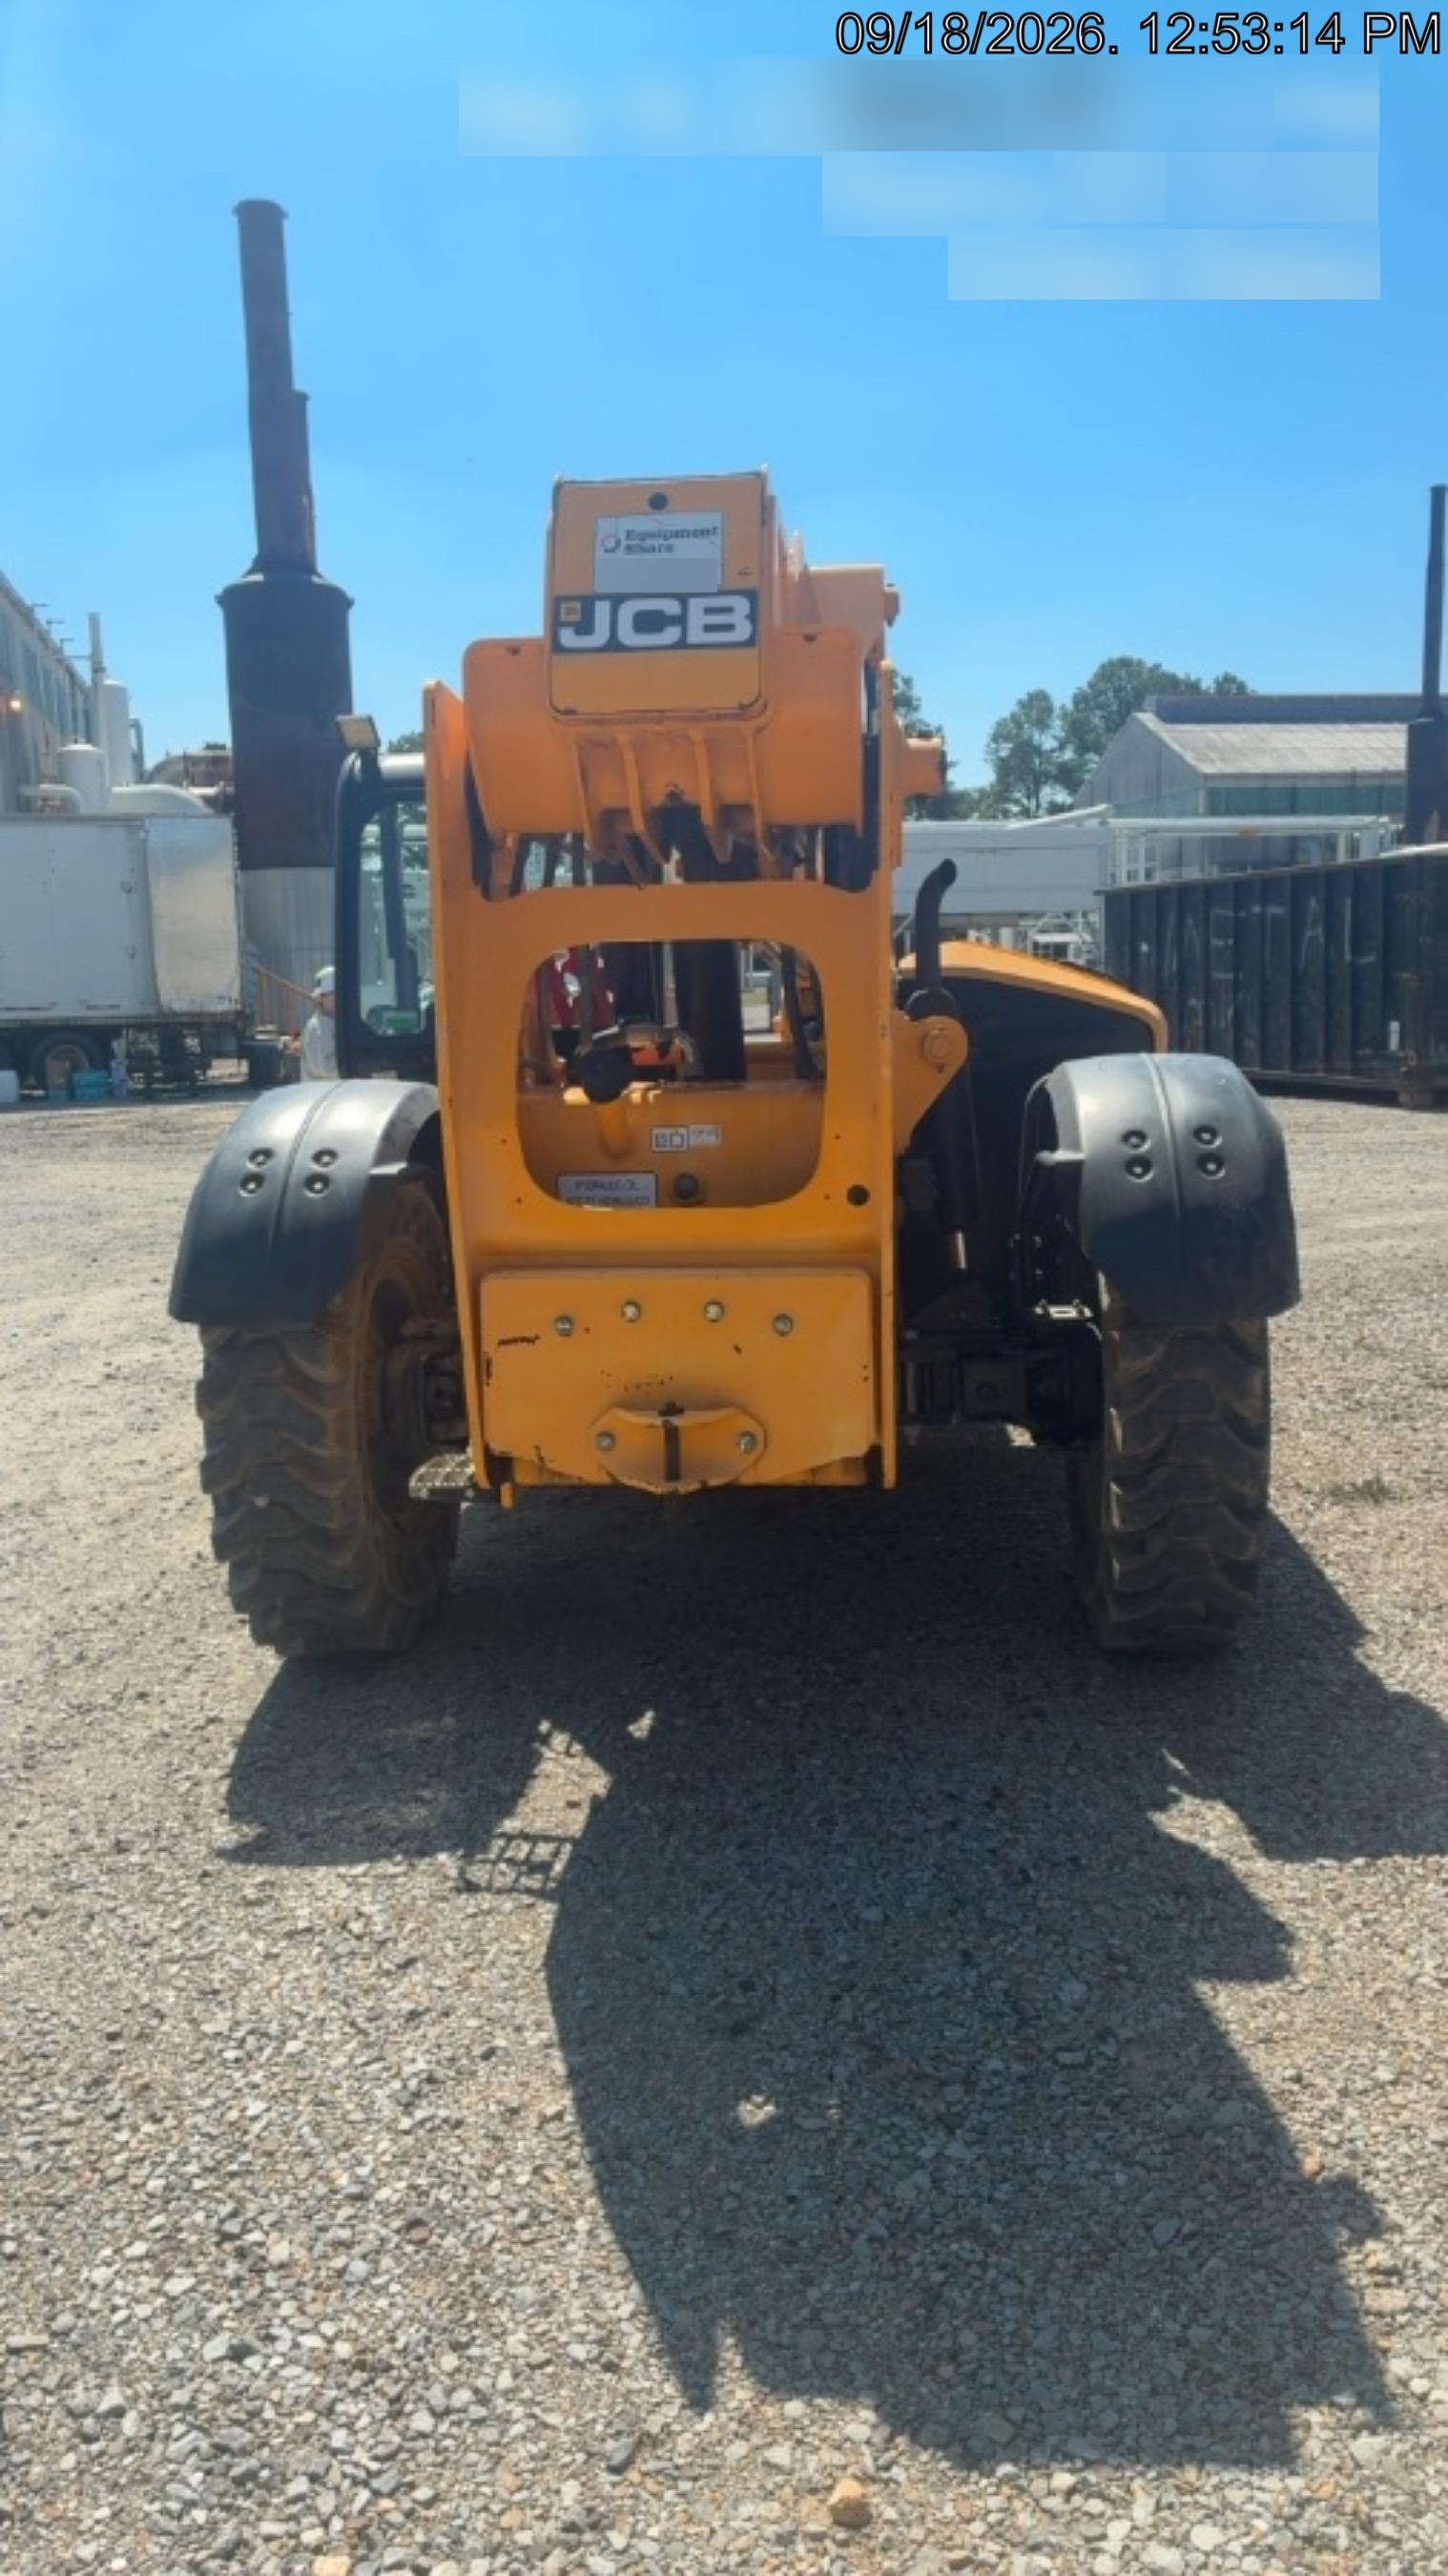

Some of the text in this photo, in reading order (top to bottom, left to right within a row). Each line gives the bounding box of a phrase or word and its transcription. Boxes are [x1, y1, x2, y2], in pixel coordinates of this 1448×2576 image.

[624, 526, 718, 541] Equipment
[623, 543, 675, 555] Share
[558, 594, 755, 649] JCB
